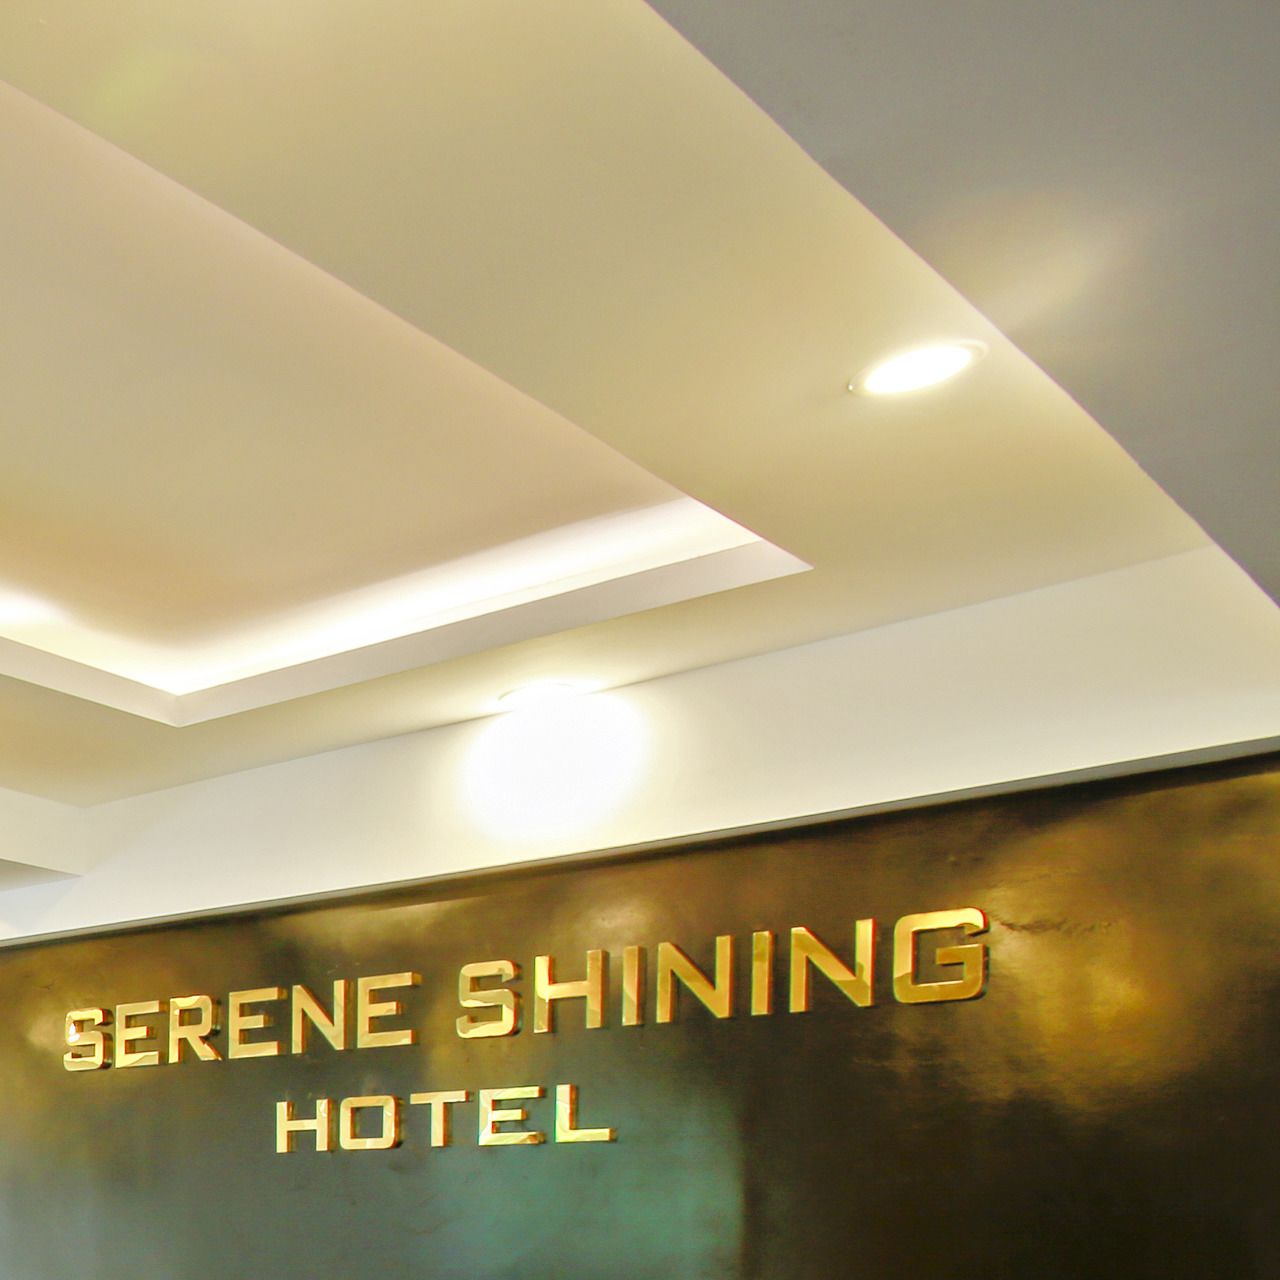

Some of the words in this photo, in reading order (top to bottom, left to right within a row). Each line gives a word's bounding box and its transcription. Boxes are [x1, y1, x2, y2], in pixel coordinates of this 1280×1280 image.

[63, 970, 422, 1071] SERENE
[456, 906, 989, 1039] SHINING
[275, 1083, 616, 1154] HOTEL
